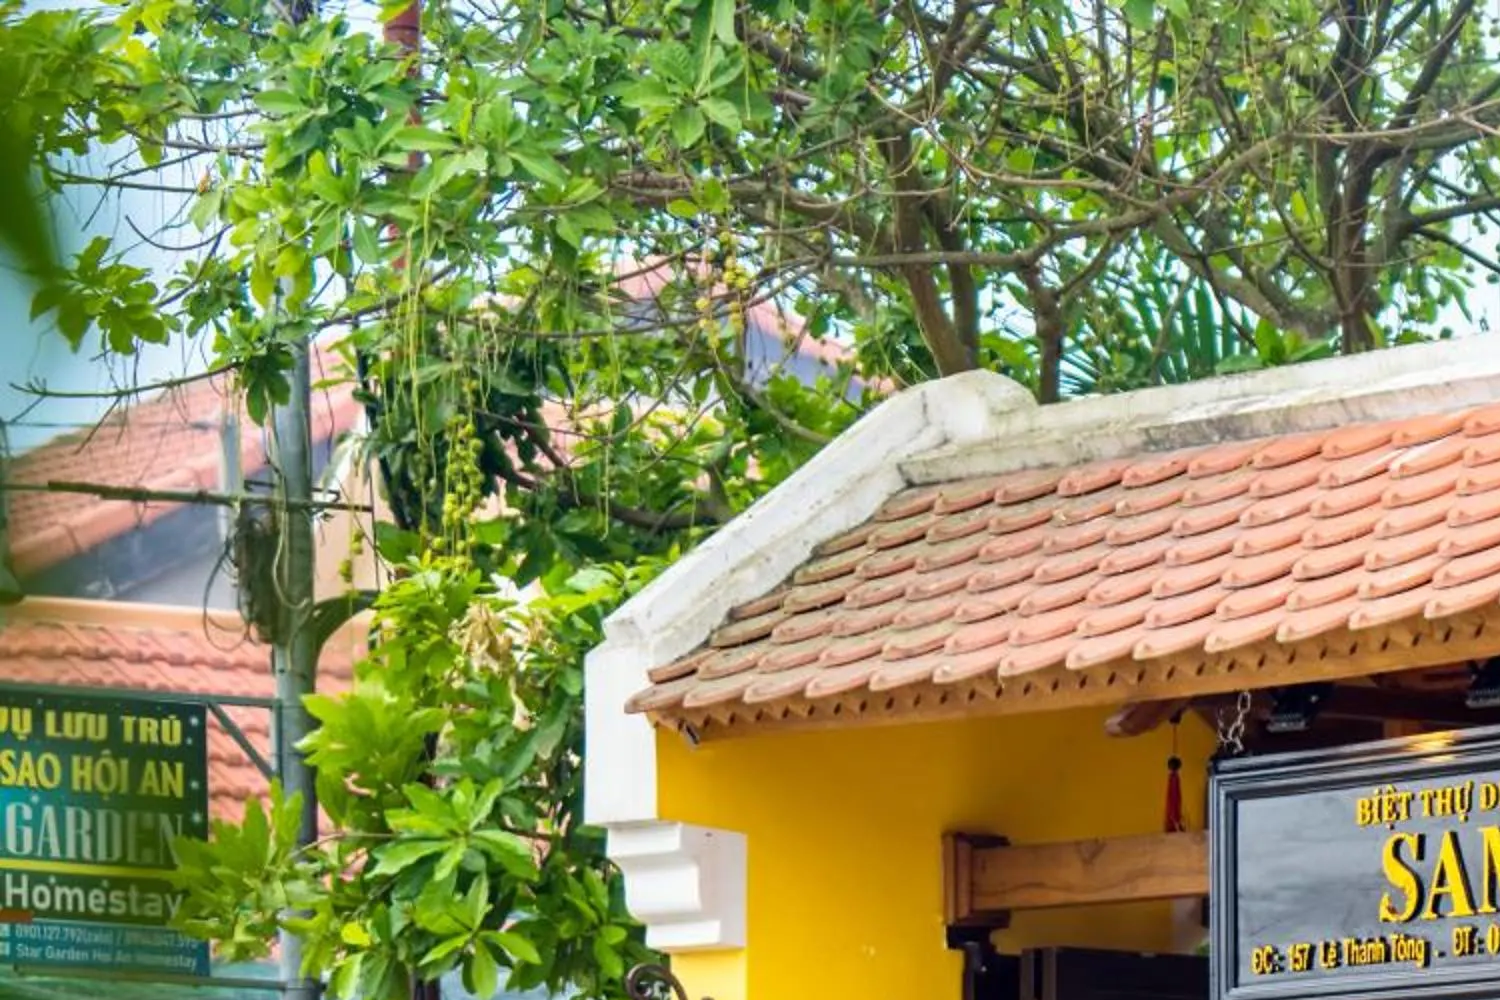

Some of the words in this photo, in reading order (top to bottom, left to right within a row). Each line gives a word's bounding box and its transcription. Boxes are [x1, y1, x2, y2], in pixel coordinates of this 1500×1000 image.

[0, 749, 61, 789] SAO
[71, 749, 129, 801] HỘI
[137, 760, 184, 799] AN
[6, 801, 184, 871] GARDEN
[5, 873, 185, 919] Homestay
[1288, 943, 1311, 972] 157
